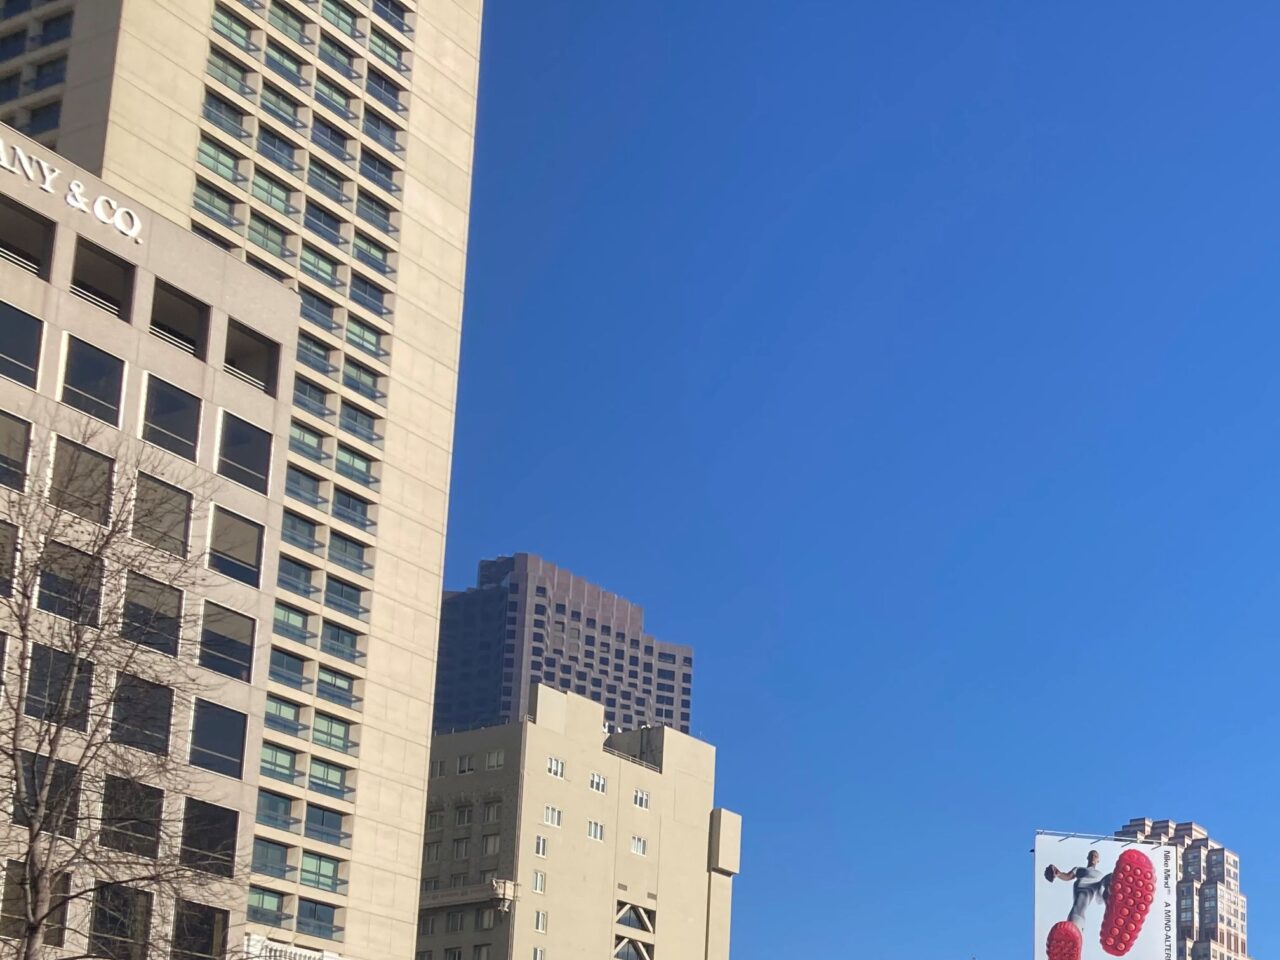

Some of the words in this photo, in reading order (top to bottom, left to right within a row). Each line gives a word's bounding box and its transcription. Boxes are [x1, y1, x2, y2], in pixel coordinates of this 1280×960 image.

[65, 180, 91, 214] &
[93, 195, 143, 245] CO.
[1163, 850, 1171, 870] Nike
